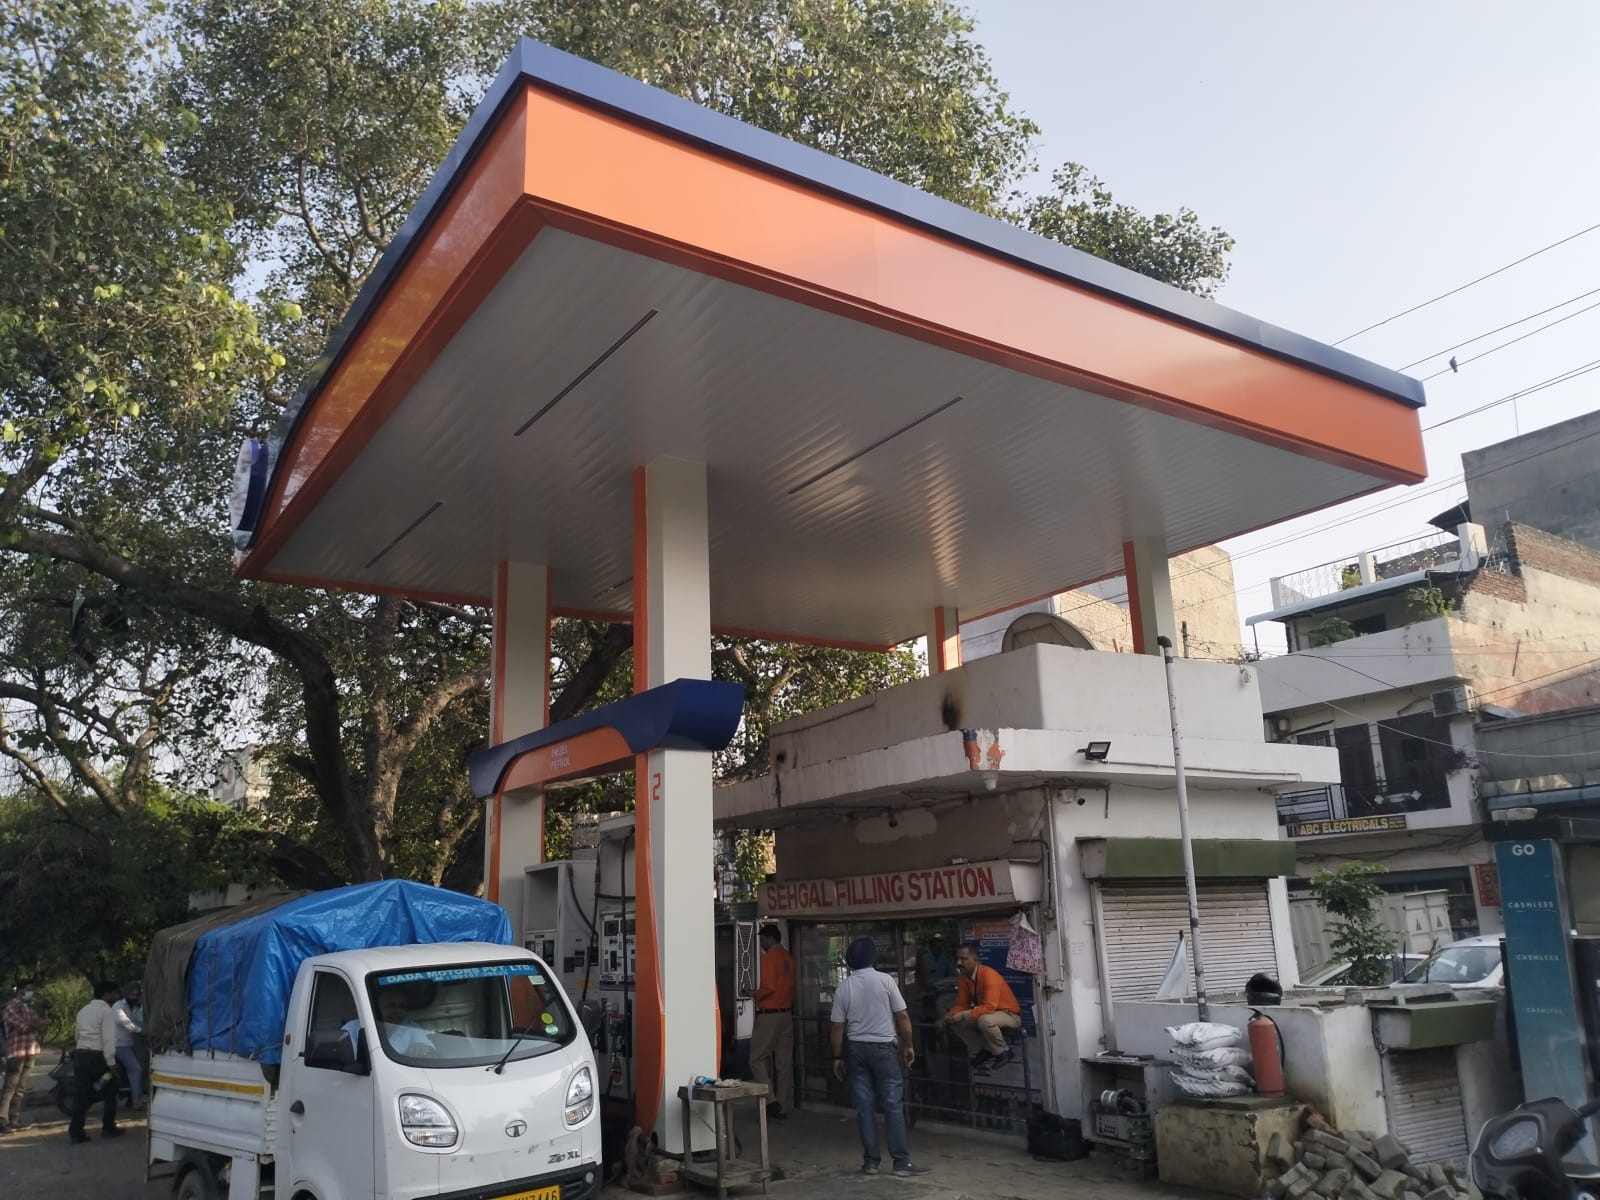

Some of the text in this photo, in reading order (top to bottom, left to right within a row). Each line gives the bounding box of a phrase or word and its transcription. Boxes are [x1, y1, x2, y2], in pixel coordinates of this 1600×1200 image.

[653, 773, 661, 800] 2
[1300, 823, 1321, 836] ABC
[1322, 818, 1389, 833] ELECTRICALS
[1512, 844, 1536, 856] GO
[767, 866, 997, 911] SEHGAL FILLING STATION
[1507, 901, 1554, 909] CASHLESS
[1516, 953, 1560, 961] CASHLESS
[386, 972, 424, 984] DADA
[427, 967, 480, 979] MOTORS
